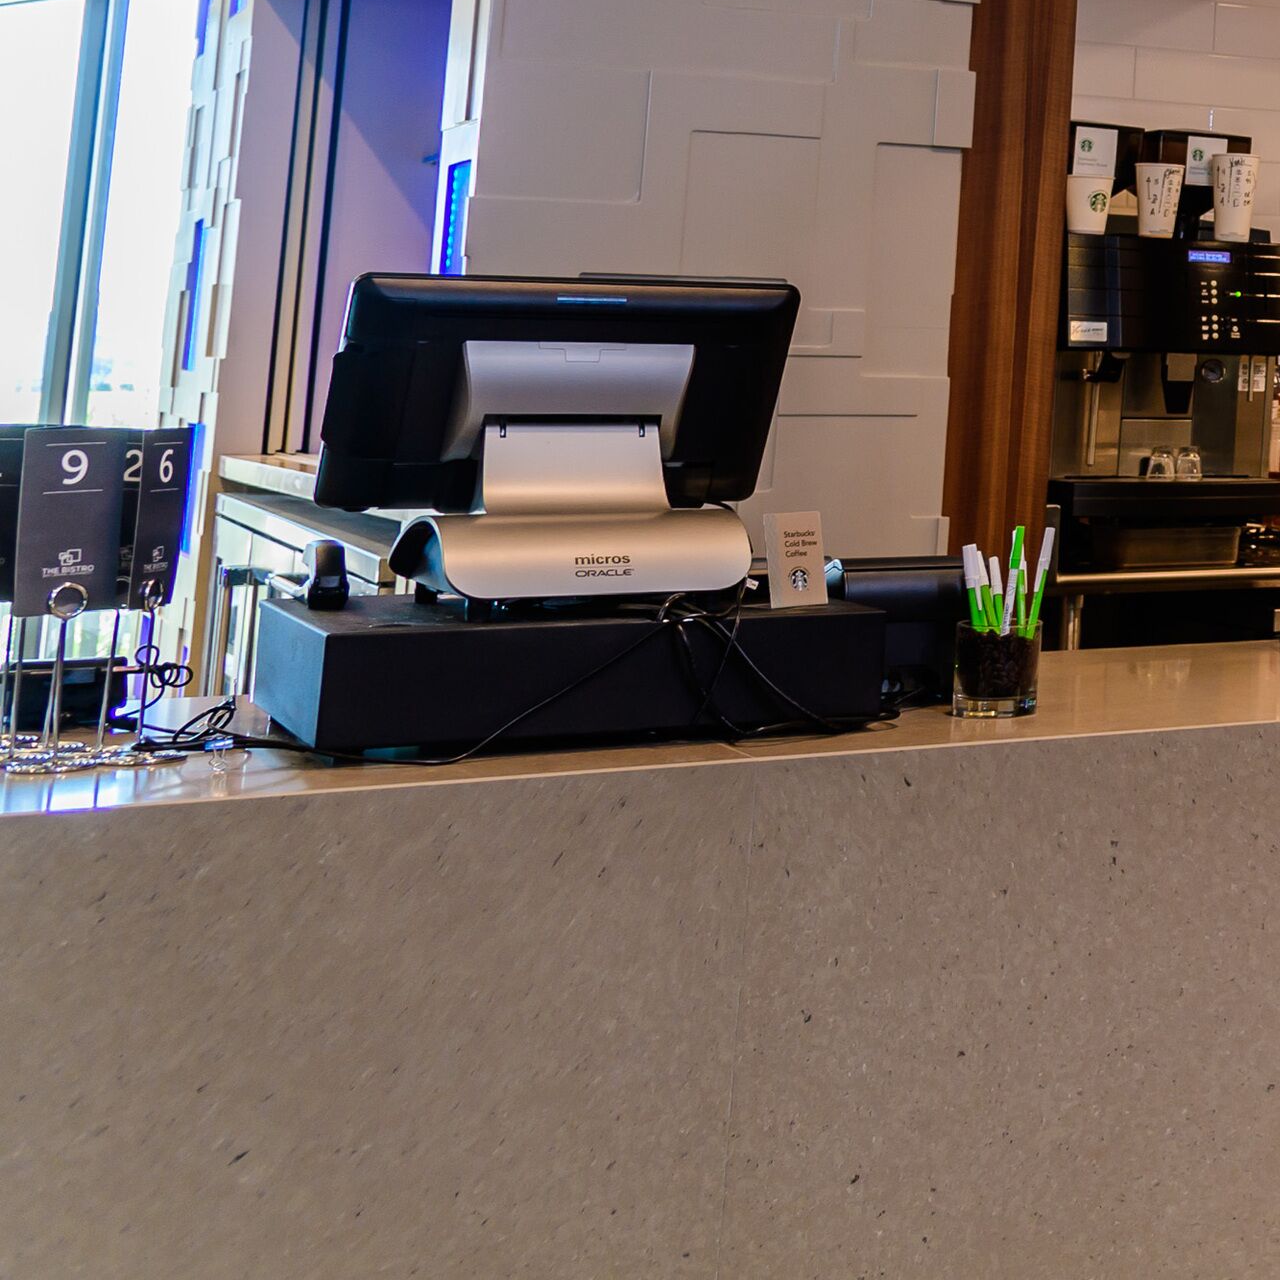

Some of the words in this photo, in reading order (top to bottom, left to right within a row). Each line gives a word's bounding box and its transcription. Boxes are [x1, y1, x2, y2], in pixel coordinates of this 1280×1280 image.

[61, 449, 88, 484] 9
[123, 449, 143, 481] 2
[159, 449, 174, 483] 6
[784, 530, 816, 538] Starbucks
[575, 554, 630, 565] micros
[42, 567, 58, 575] THE
[62, 564, 94, 573] BISTRO
[575, 569, 632, 577] ORACLE
